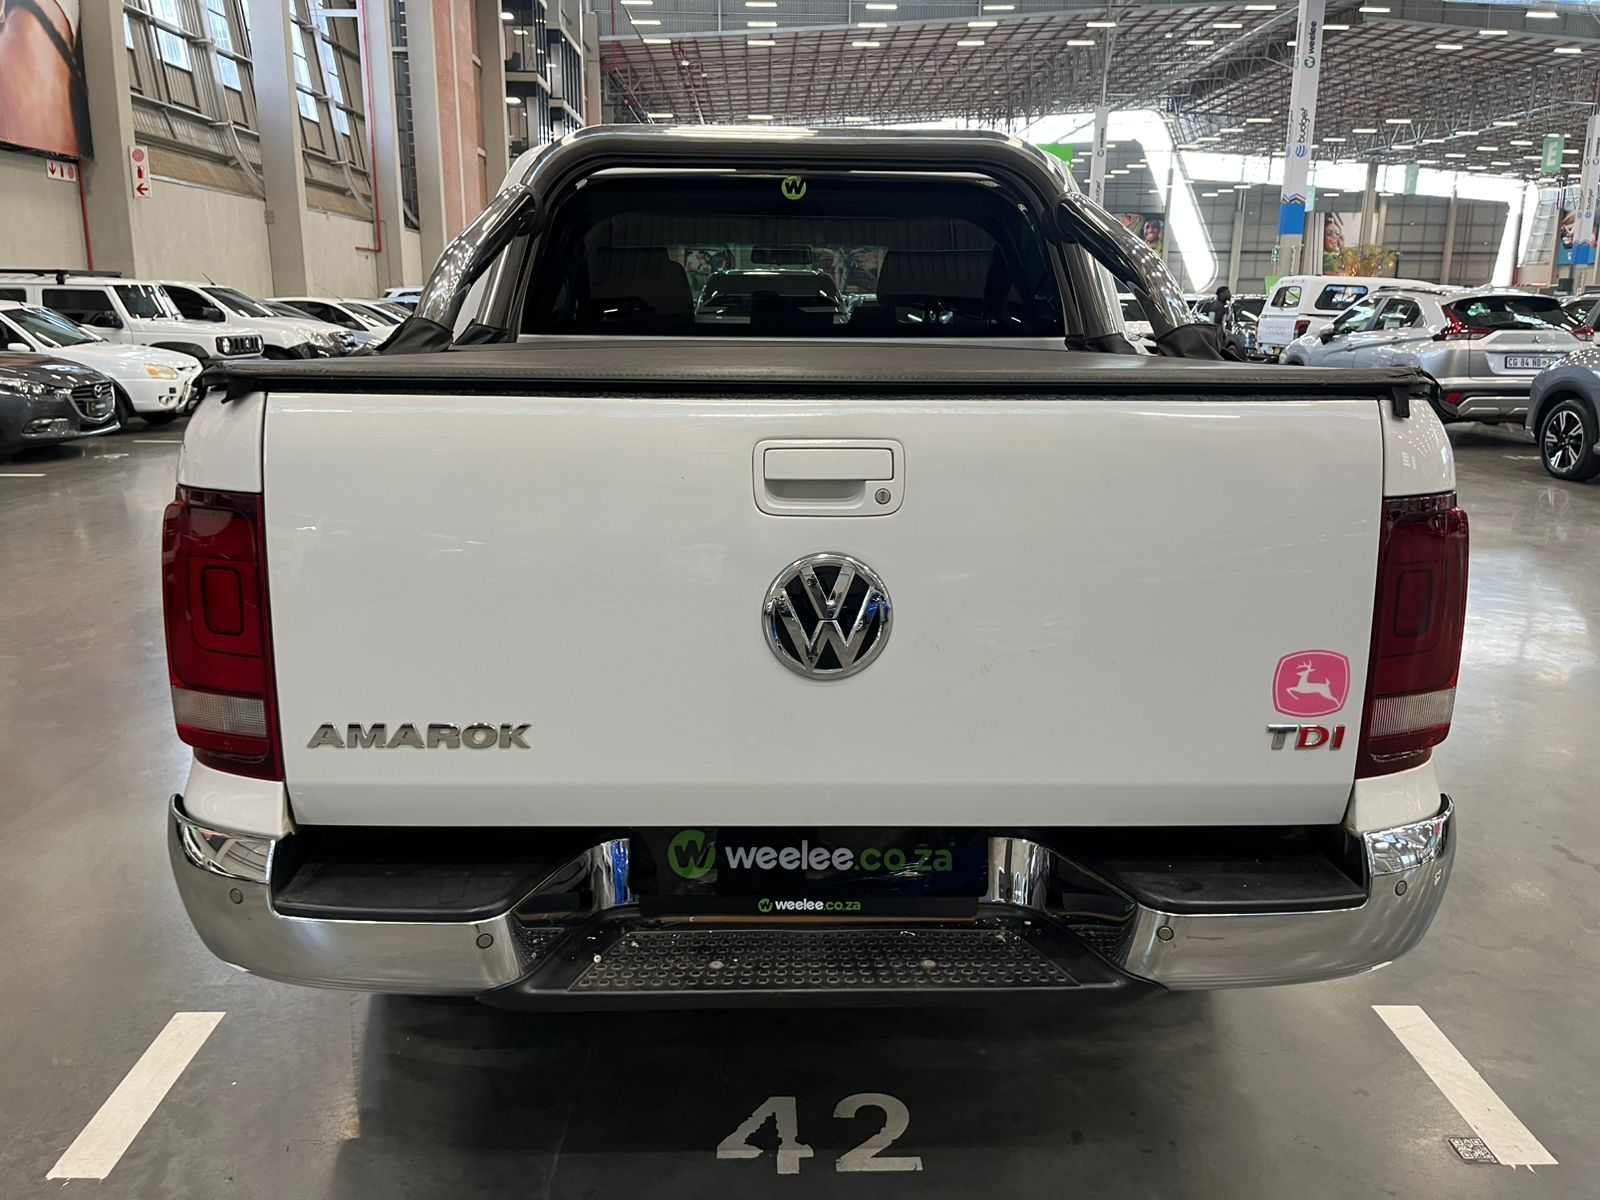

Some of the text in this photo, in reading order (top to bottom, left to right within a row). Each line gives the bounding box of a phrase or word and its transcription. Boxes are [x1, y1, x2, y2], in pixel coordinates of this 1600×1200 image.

[1308, 20, 1317, 54] weelee
[1298, 107, 1311, 144] budget
[1546, 141, 1559, 167] E
[1508, 357, 1518, 367] CG
[1520, 357, 1529, 367] 84
[1532, 357, 1542, 367] NB
[306, 722, 533, 750] AMAROK
[1266, 723, 1346, 751] TDI
[725, 839, 953, 871] weelee.coza
[774, 898, 862, 912] weelee.co.za
[716, 1092, 923, 1175] 42
